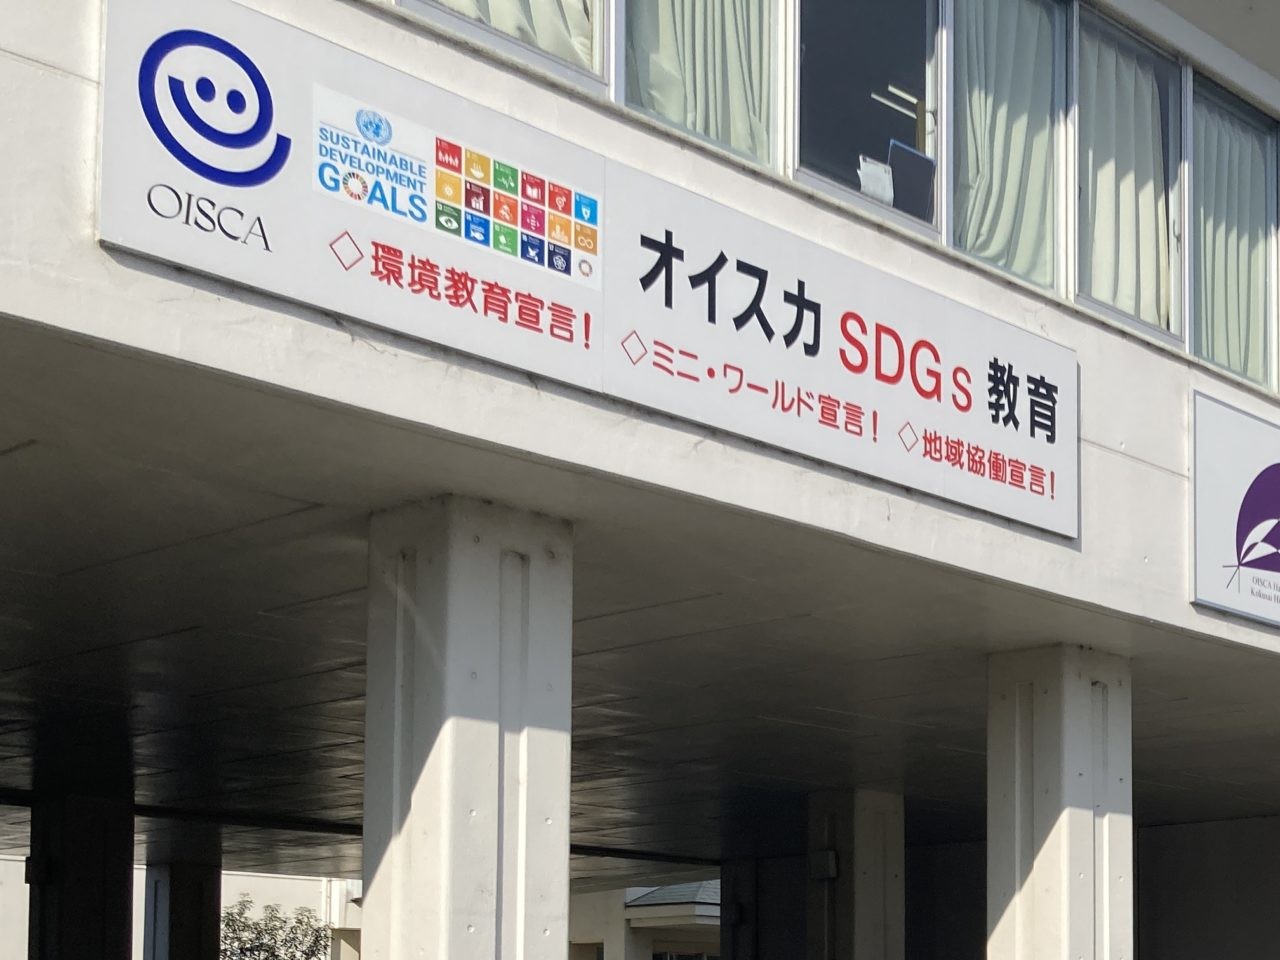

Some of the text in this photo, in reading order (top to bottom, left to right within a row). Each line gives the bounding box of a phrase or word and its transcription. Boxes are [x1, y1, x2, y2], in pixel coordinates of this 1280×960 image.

[318, 127, 427, 179] SUSTAINABLE
[318, 143, 427, 193] DEVELOPMENT
[146, 183, 273, 253] OISCA
[318, 162, 427, 223] GOALS
[639, 229, 1060, 444] オイスカ SDGs 教育
